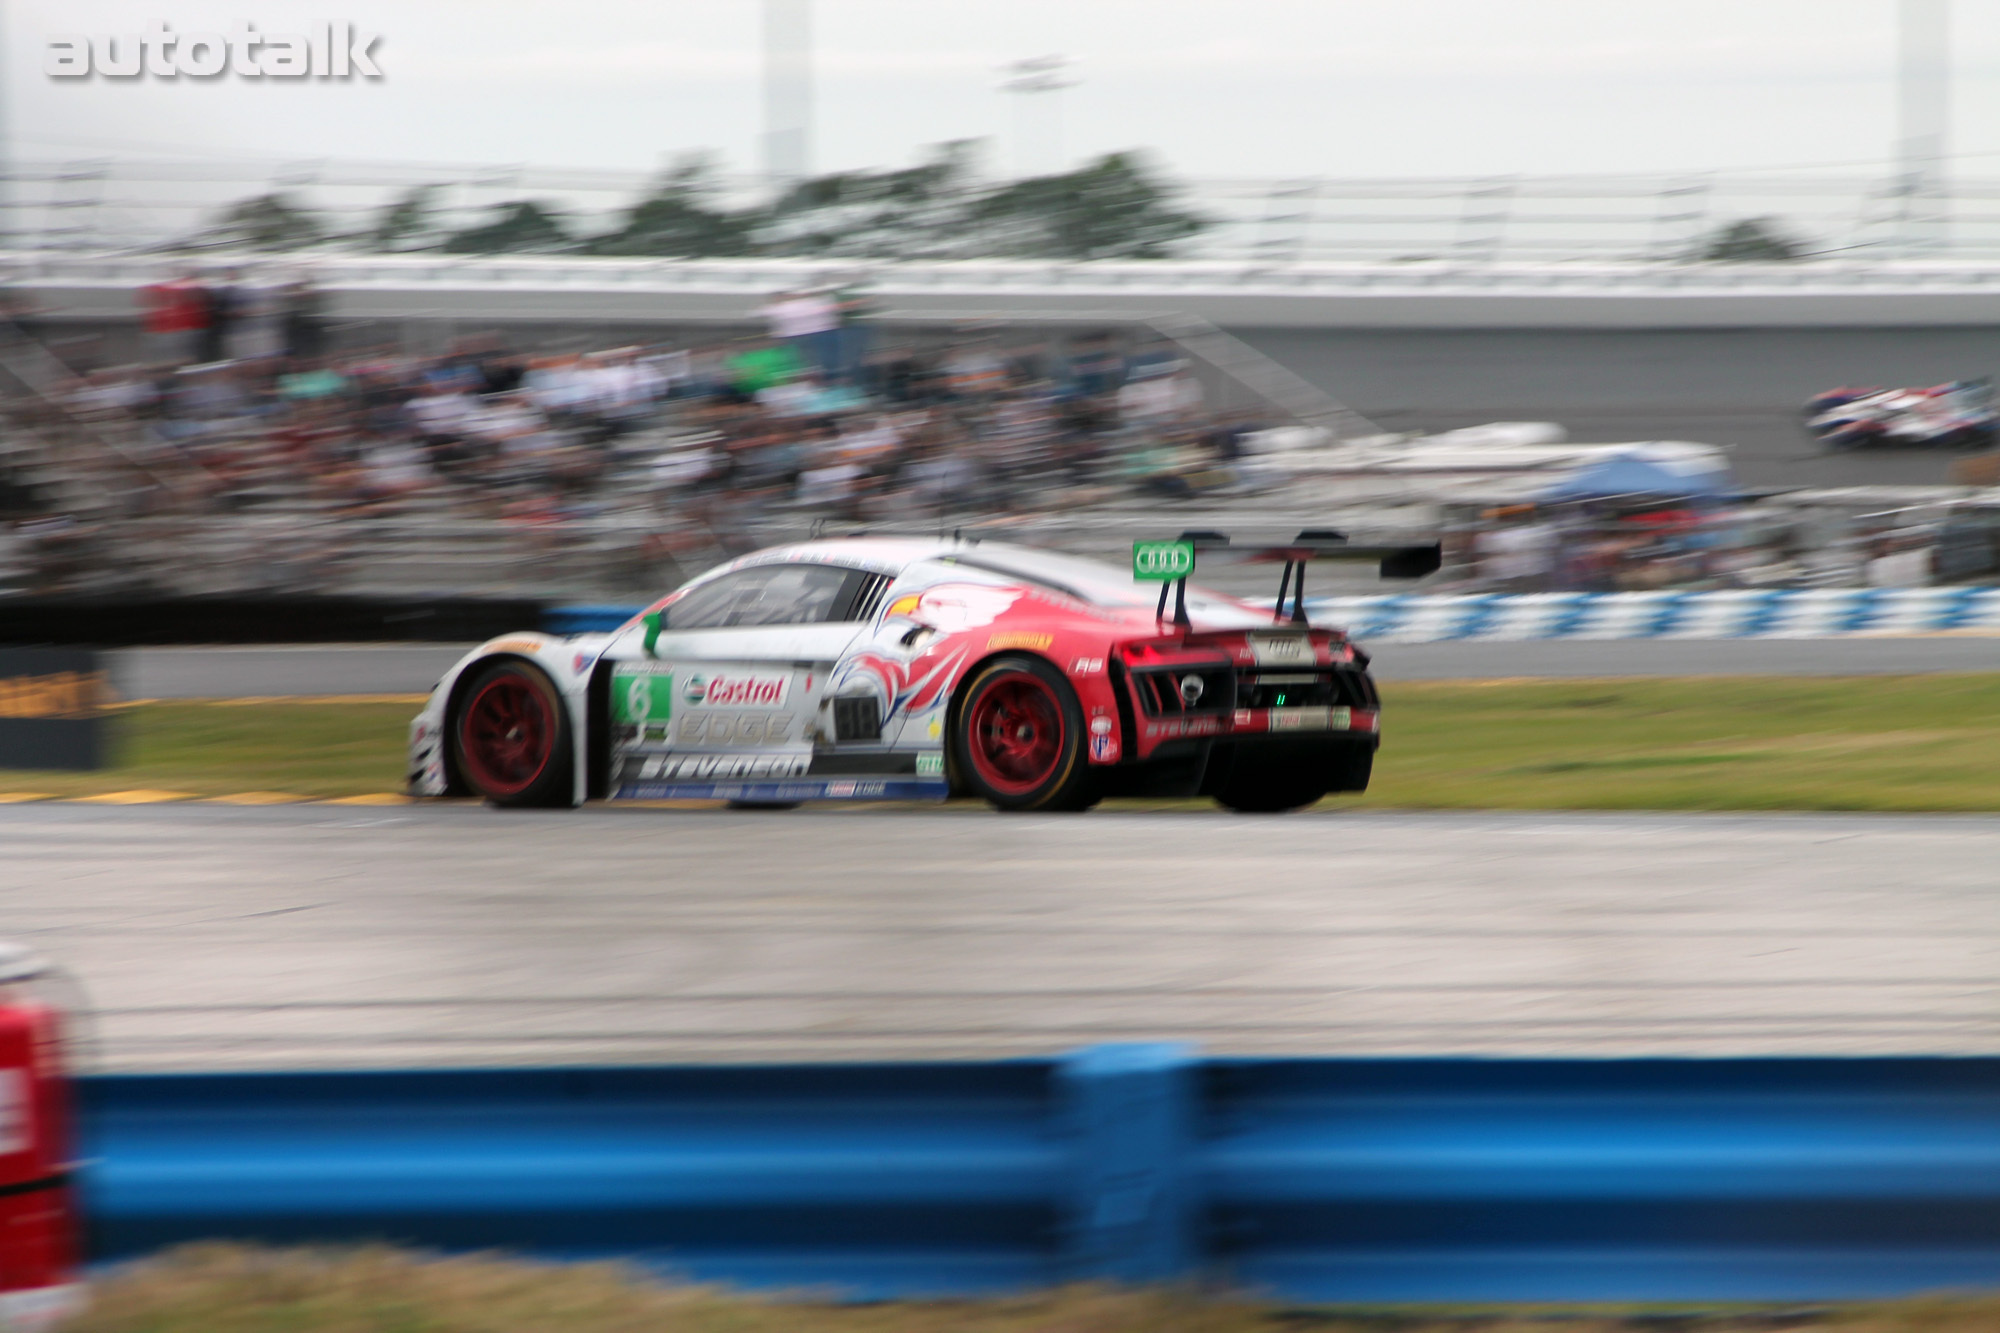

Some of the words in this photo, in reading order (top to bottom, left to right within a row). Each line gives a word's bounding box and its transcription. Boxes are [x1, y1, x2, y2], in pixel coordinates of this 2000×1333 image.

[627, 676, 652, 721] 6
[707, 674, 785, 705] Castrol
[677, 711, 796, 745] EDGE
